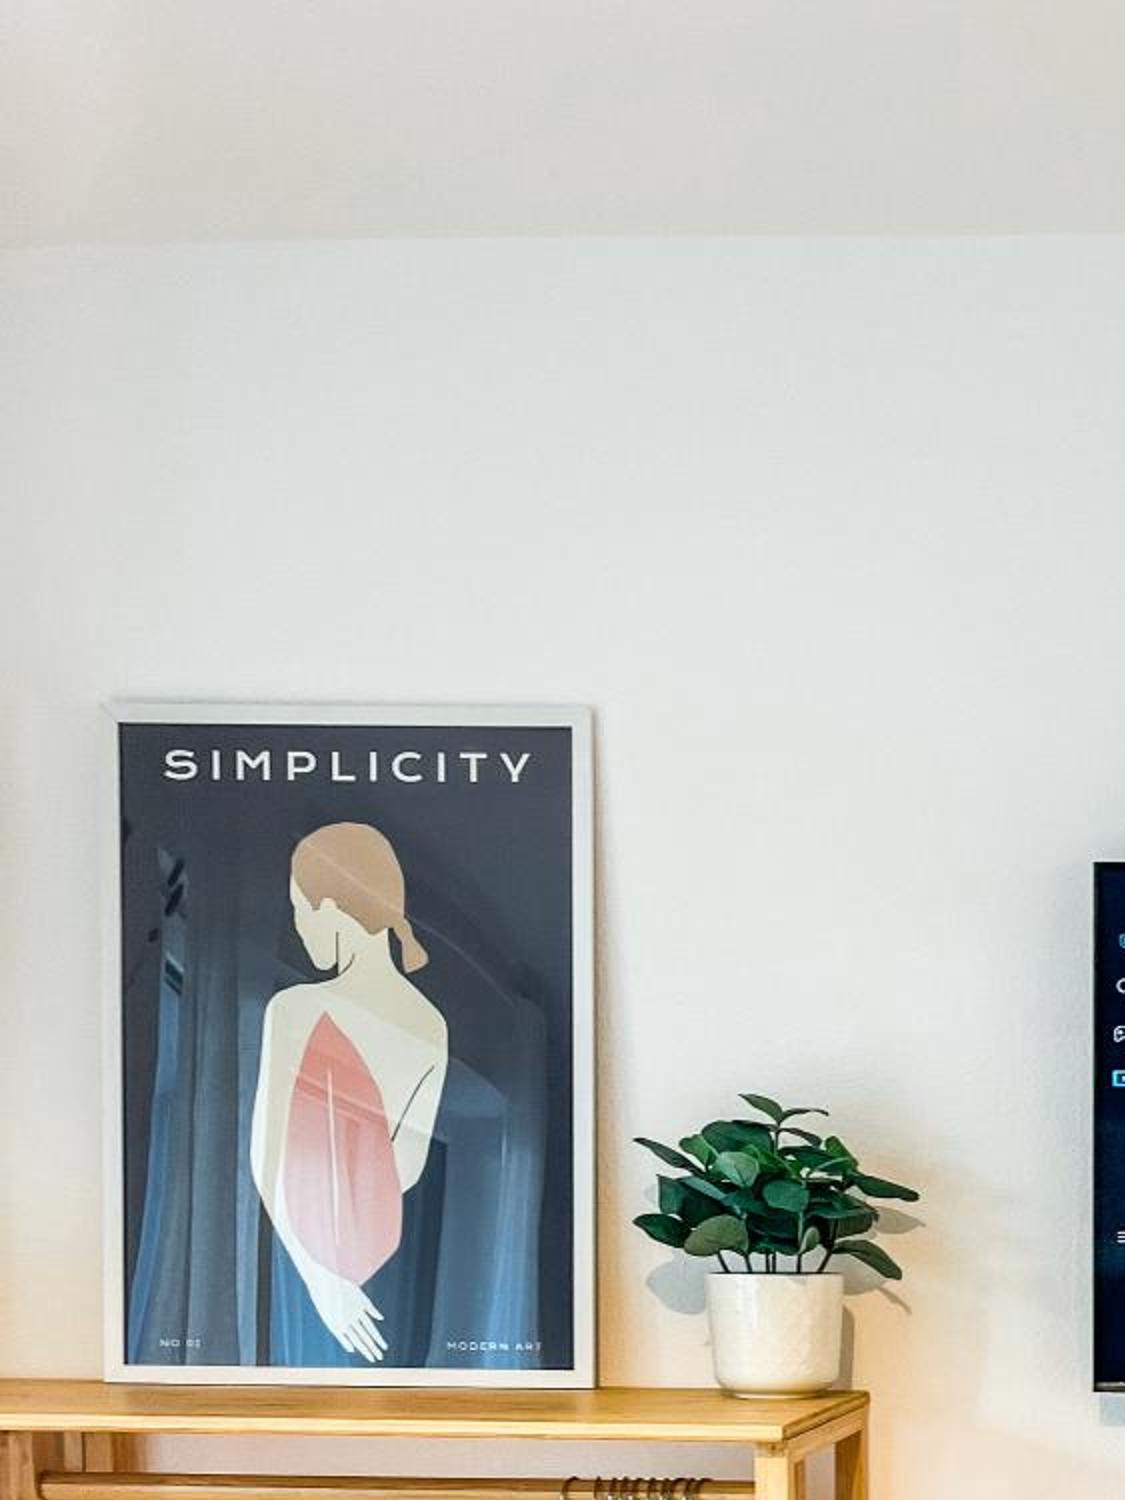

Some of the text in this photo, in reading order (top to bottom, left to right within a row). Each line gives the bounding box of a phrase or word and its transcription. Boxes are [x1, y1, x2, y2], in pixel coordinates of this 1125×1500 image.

[163, 749, 532, 783] SIMPLICITY
[446, 1340, 542, 1353] MODERN ART
